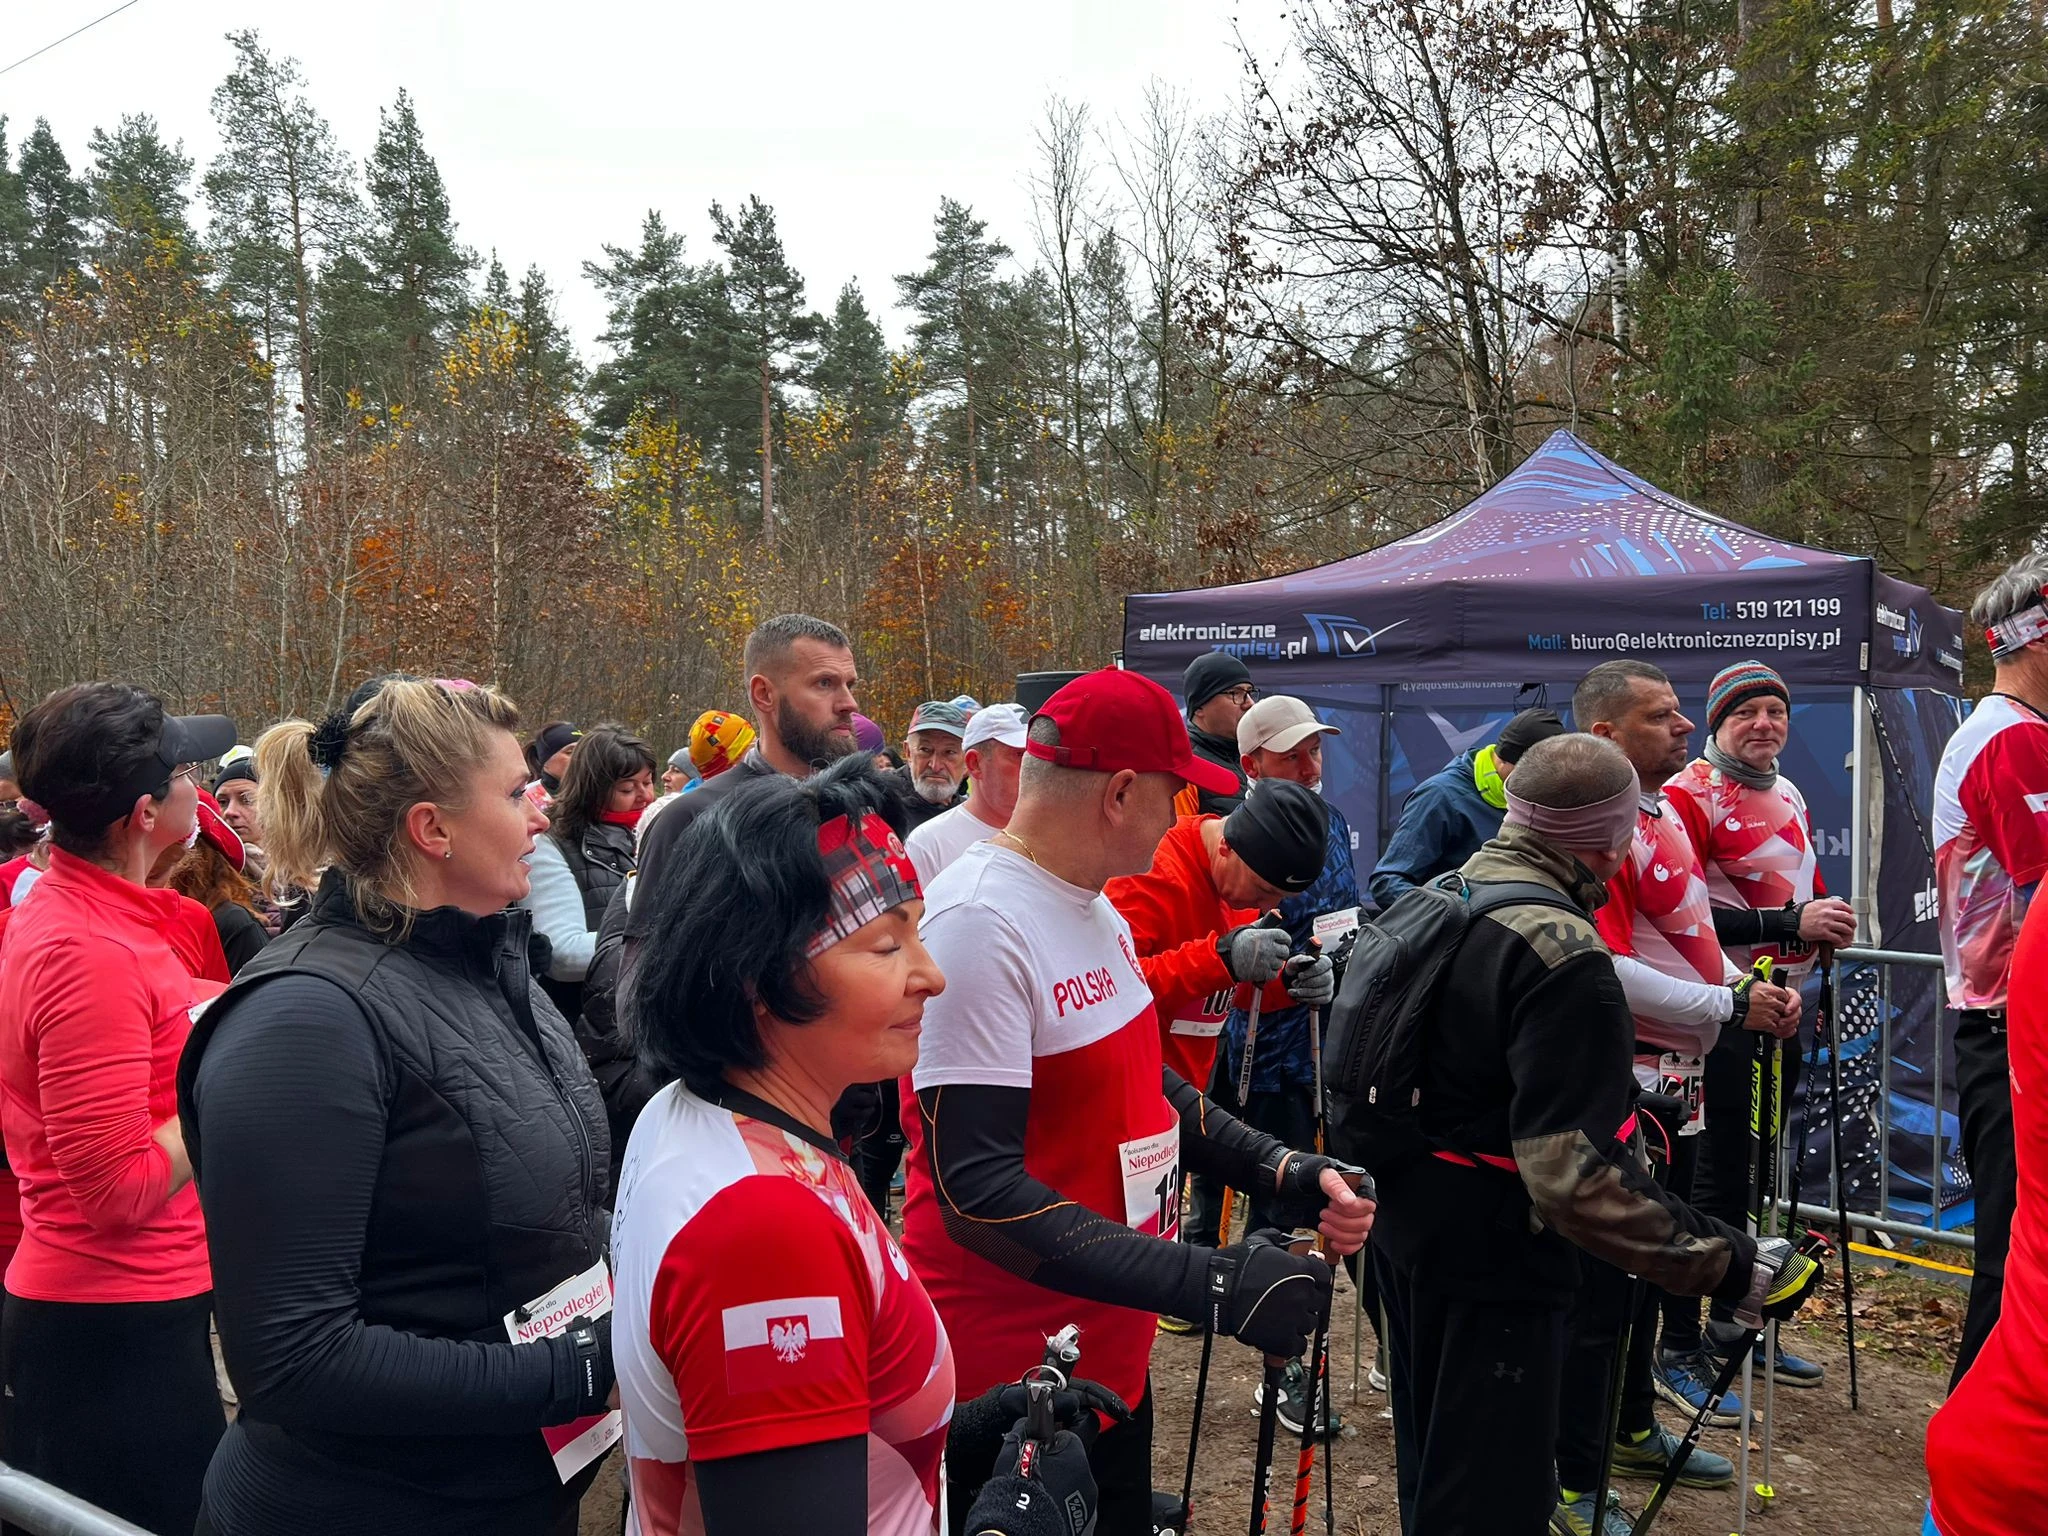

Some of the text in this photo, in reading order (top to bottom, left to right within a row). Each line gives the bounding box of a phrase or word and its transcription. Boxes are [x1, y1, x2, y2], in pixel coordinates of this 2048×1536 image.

[1701, 598, 1841, 620] Tel: 519 121 199
[1139, 622, 1277, 641] elektroniczne
[1211, 636, 1308, 660] zapisy.pl
[1527, 628, 1841, 651] Mail: biuro@elektronicznezapisy.pl
[1052, 965, 1119, 1018] POLSKA
[1240, 1044, 1253, 1090] GABEL
[1750, 1061, 1762, 1127] FIZAN
[1770, 1074, 1779, 1130] FIZAN
[545, 1299, 557, 1310] dla
[1688, 1394, 1721, 1446] LEKI
